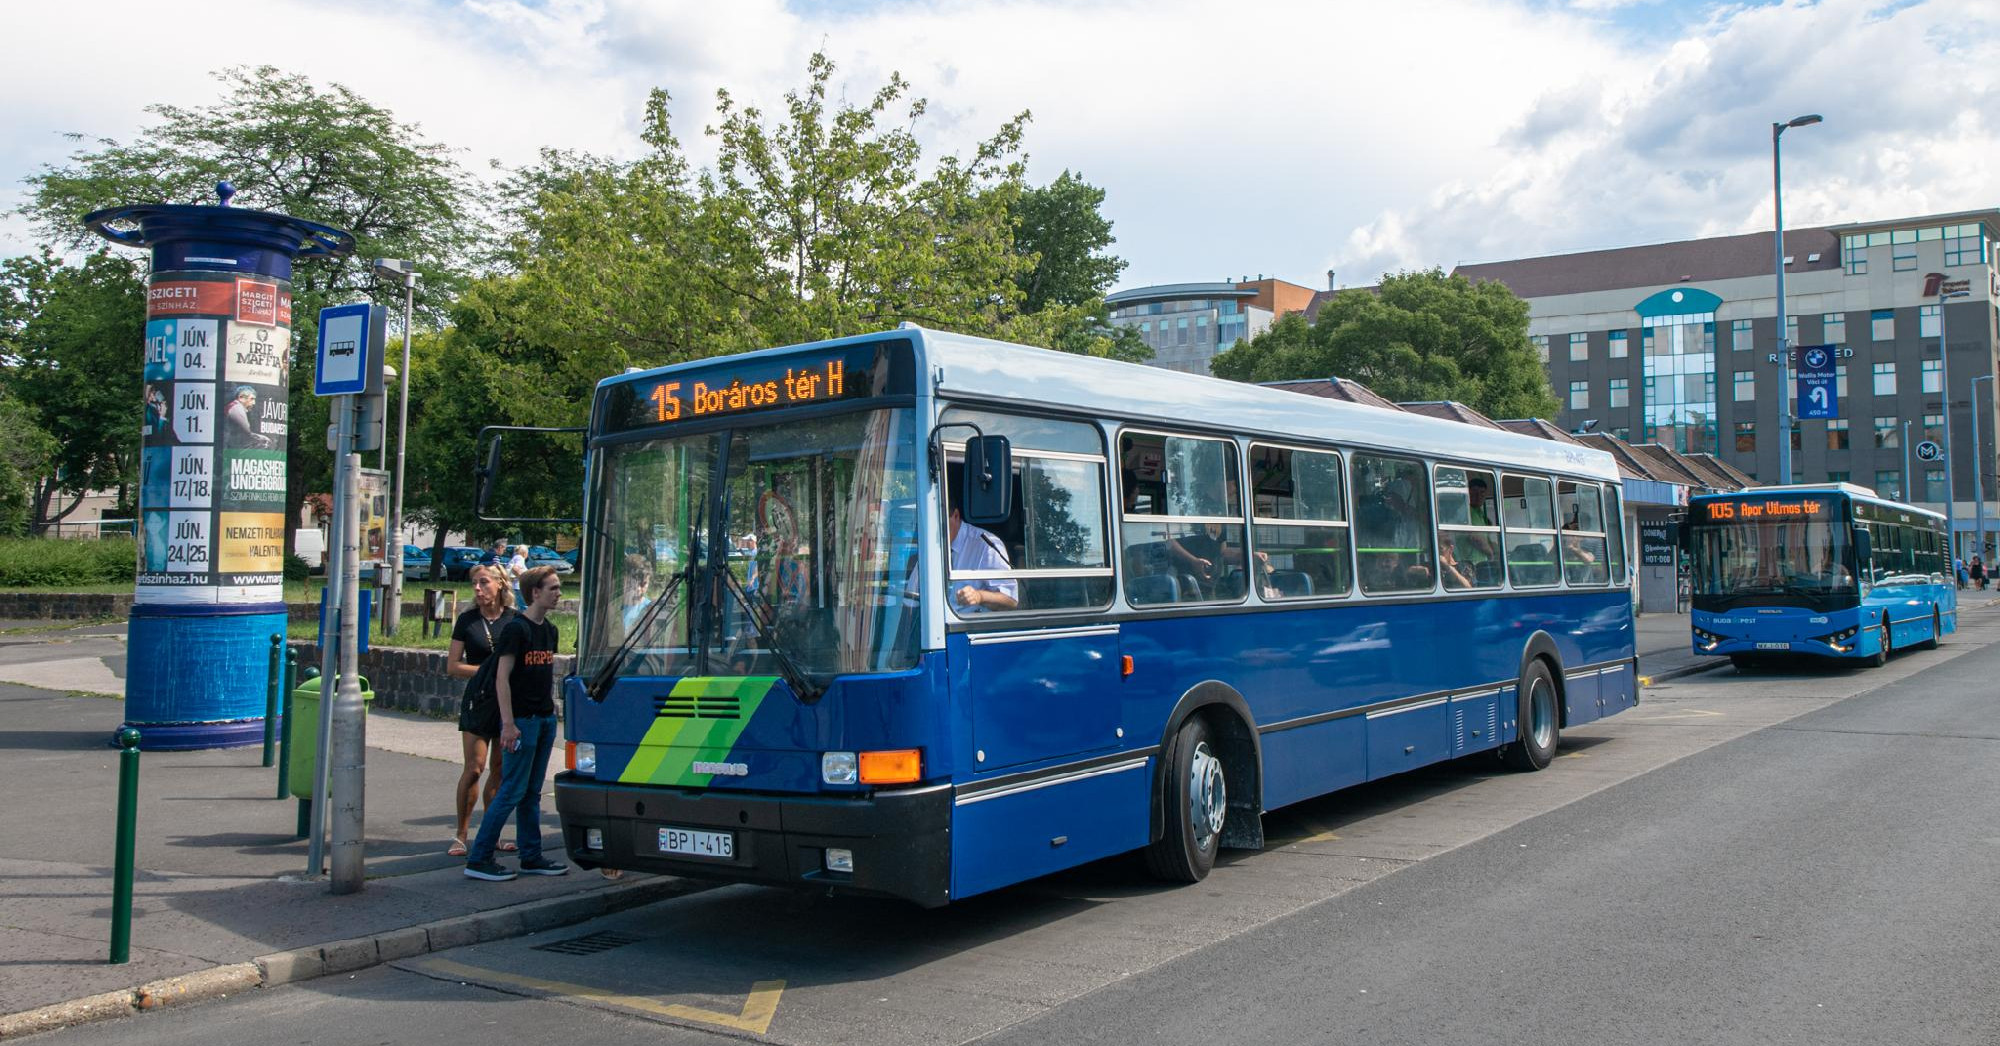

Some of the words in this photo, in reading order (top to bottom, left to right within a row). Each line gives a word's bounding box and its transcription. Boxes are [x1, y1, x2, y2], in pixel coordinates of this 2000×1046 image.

[242, 291, 273, 301] MARGIT
[181, 326, 209, 348] JÚN.
[183, 352, 206, 369] 04.
[181, 390, 209, 411] JÚN.
[651, 382, 680, 422] 15
[694, 379, 777, 415] Boráros
[785, 368, 820, 400] tér
[828, 360, 843, 395] H
[186, 415, 202, 433] 11.
[178, 454, 207, 476] JÚN.
[1707, 502, 1733, 519] 105
[1741, 503, 1763, 517] Apor
[1766, 501, 1800, 514] Vilmos
[1803, 499, 1820, 514] tér
[175, 519, 204, 539] JÚN.
[225, 527, 263, 540] NEMZETI
[668, 831, 732, 855] BPI-415
